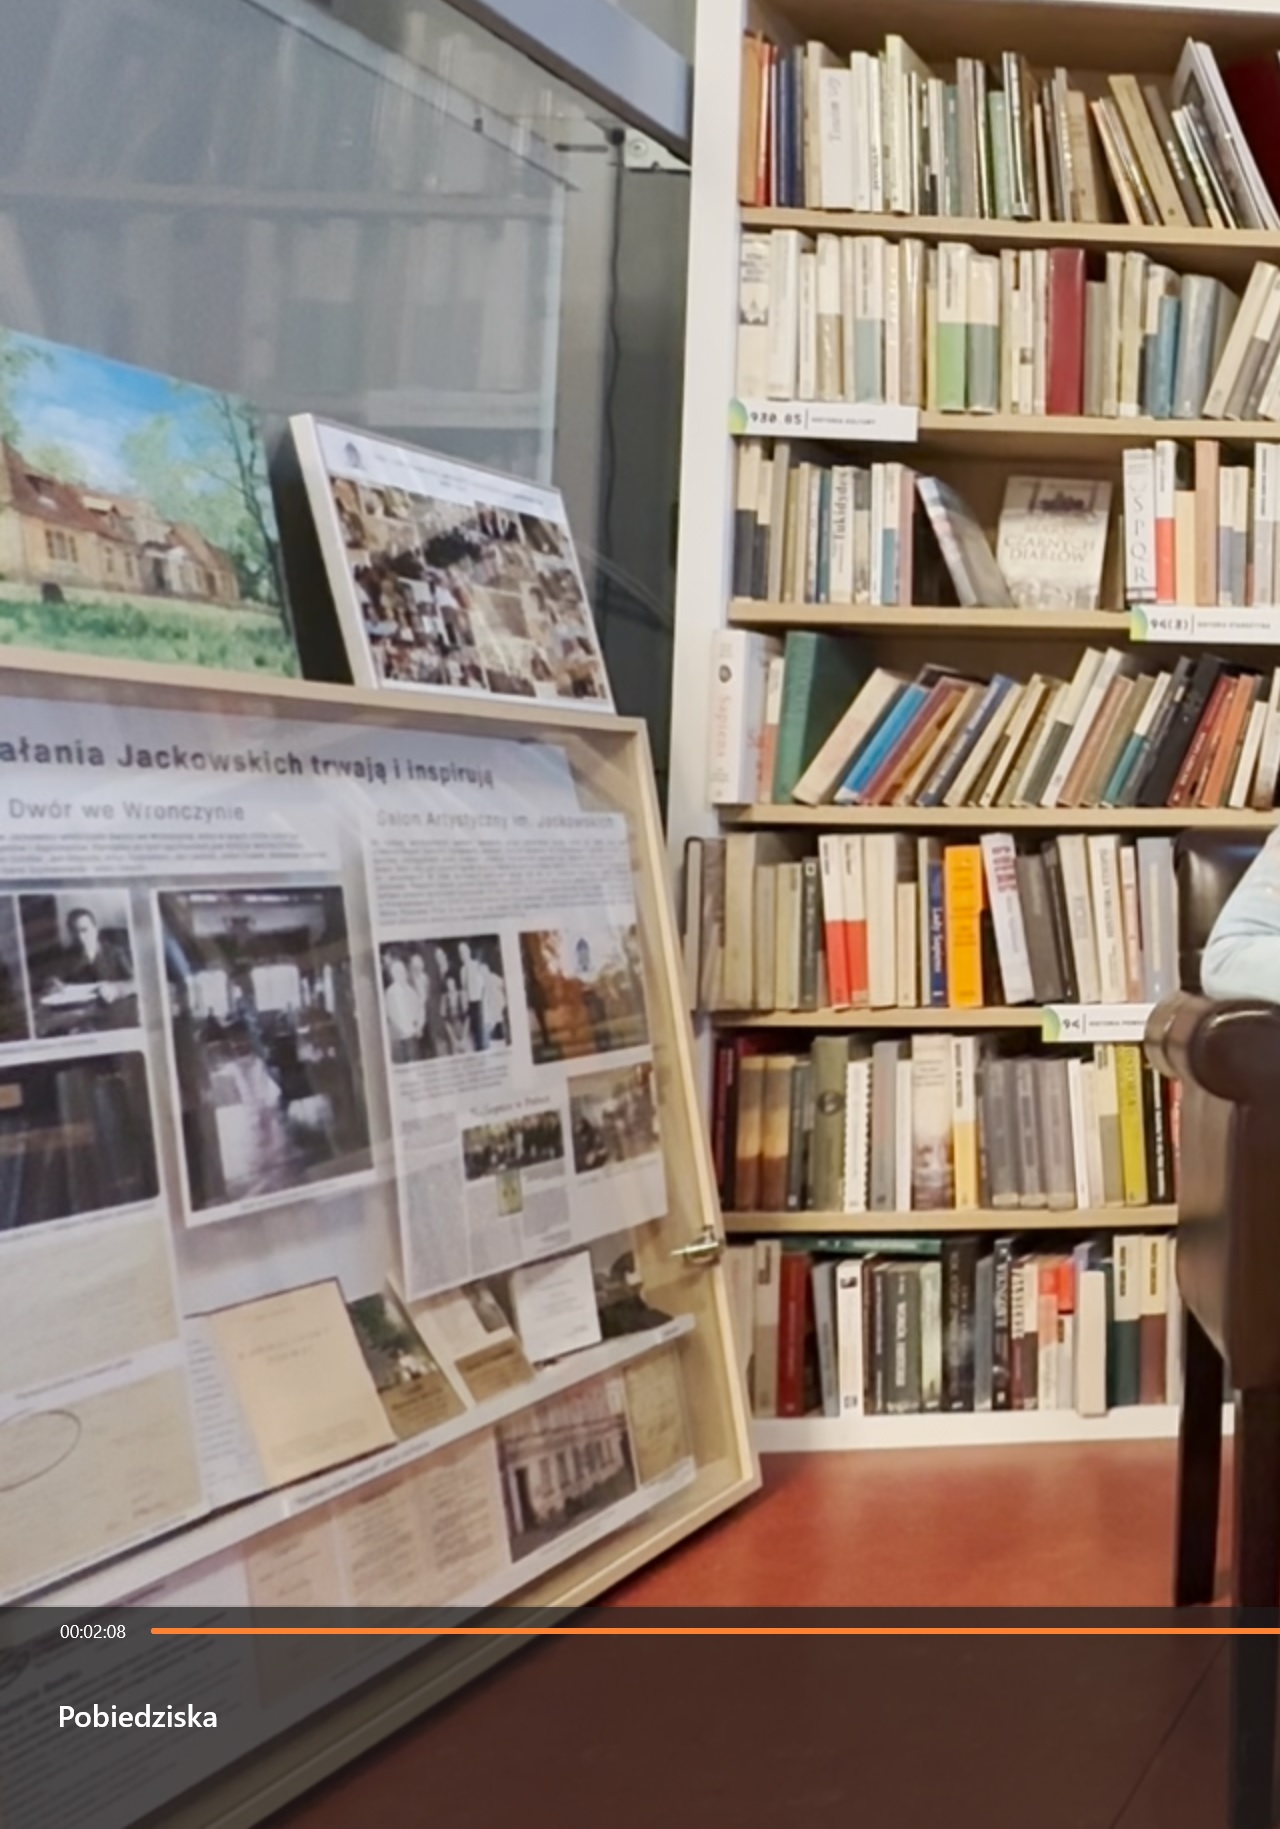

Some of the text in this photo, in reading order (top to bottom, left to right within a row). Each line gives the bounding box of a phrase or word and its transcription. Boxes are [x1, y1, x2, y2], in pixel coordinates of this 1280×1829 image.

[1131, 496, 1147, 583] SPQR
[715, 695, 731, 758] Sapiens
[116, 743, 304, 777] Jackowskich
[310, 753, 387, 785] trwają
[407, 758, 495, 790] inspirują
[8, 798, 246, 824] Dwór we Wronczynie
[377, 809, 421, 827] Salon
[426, 811, 508, 831] Artystyczny
[537, 814, 614, 830] Jackowskich
